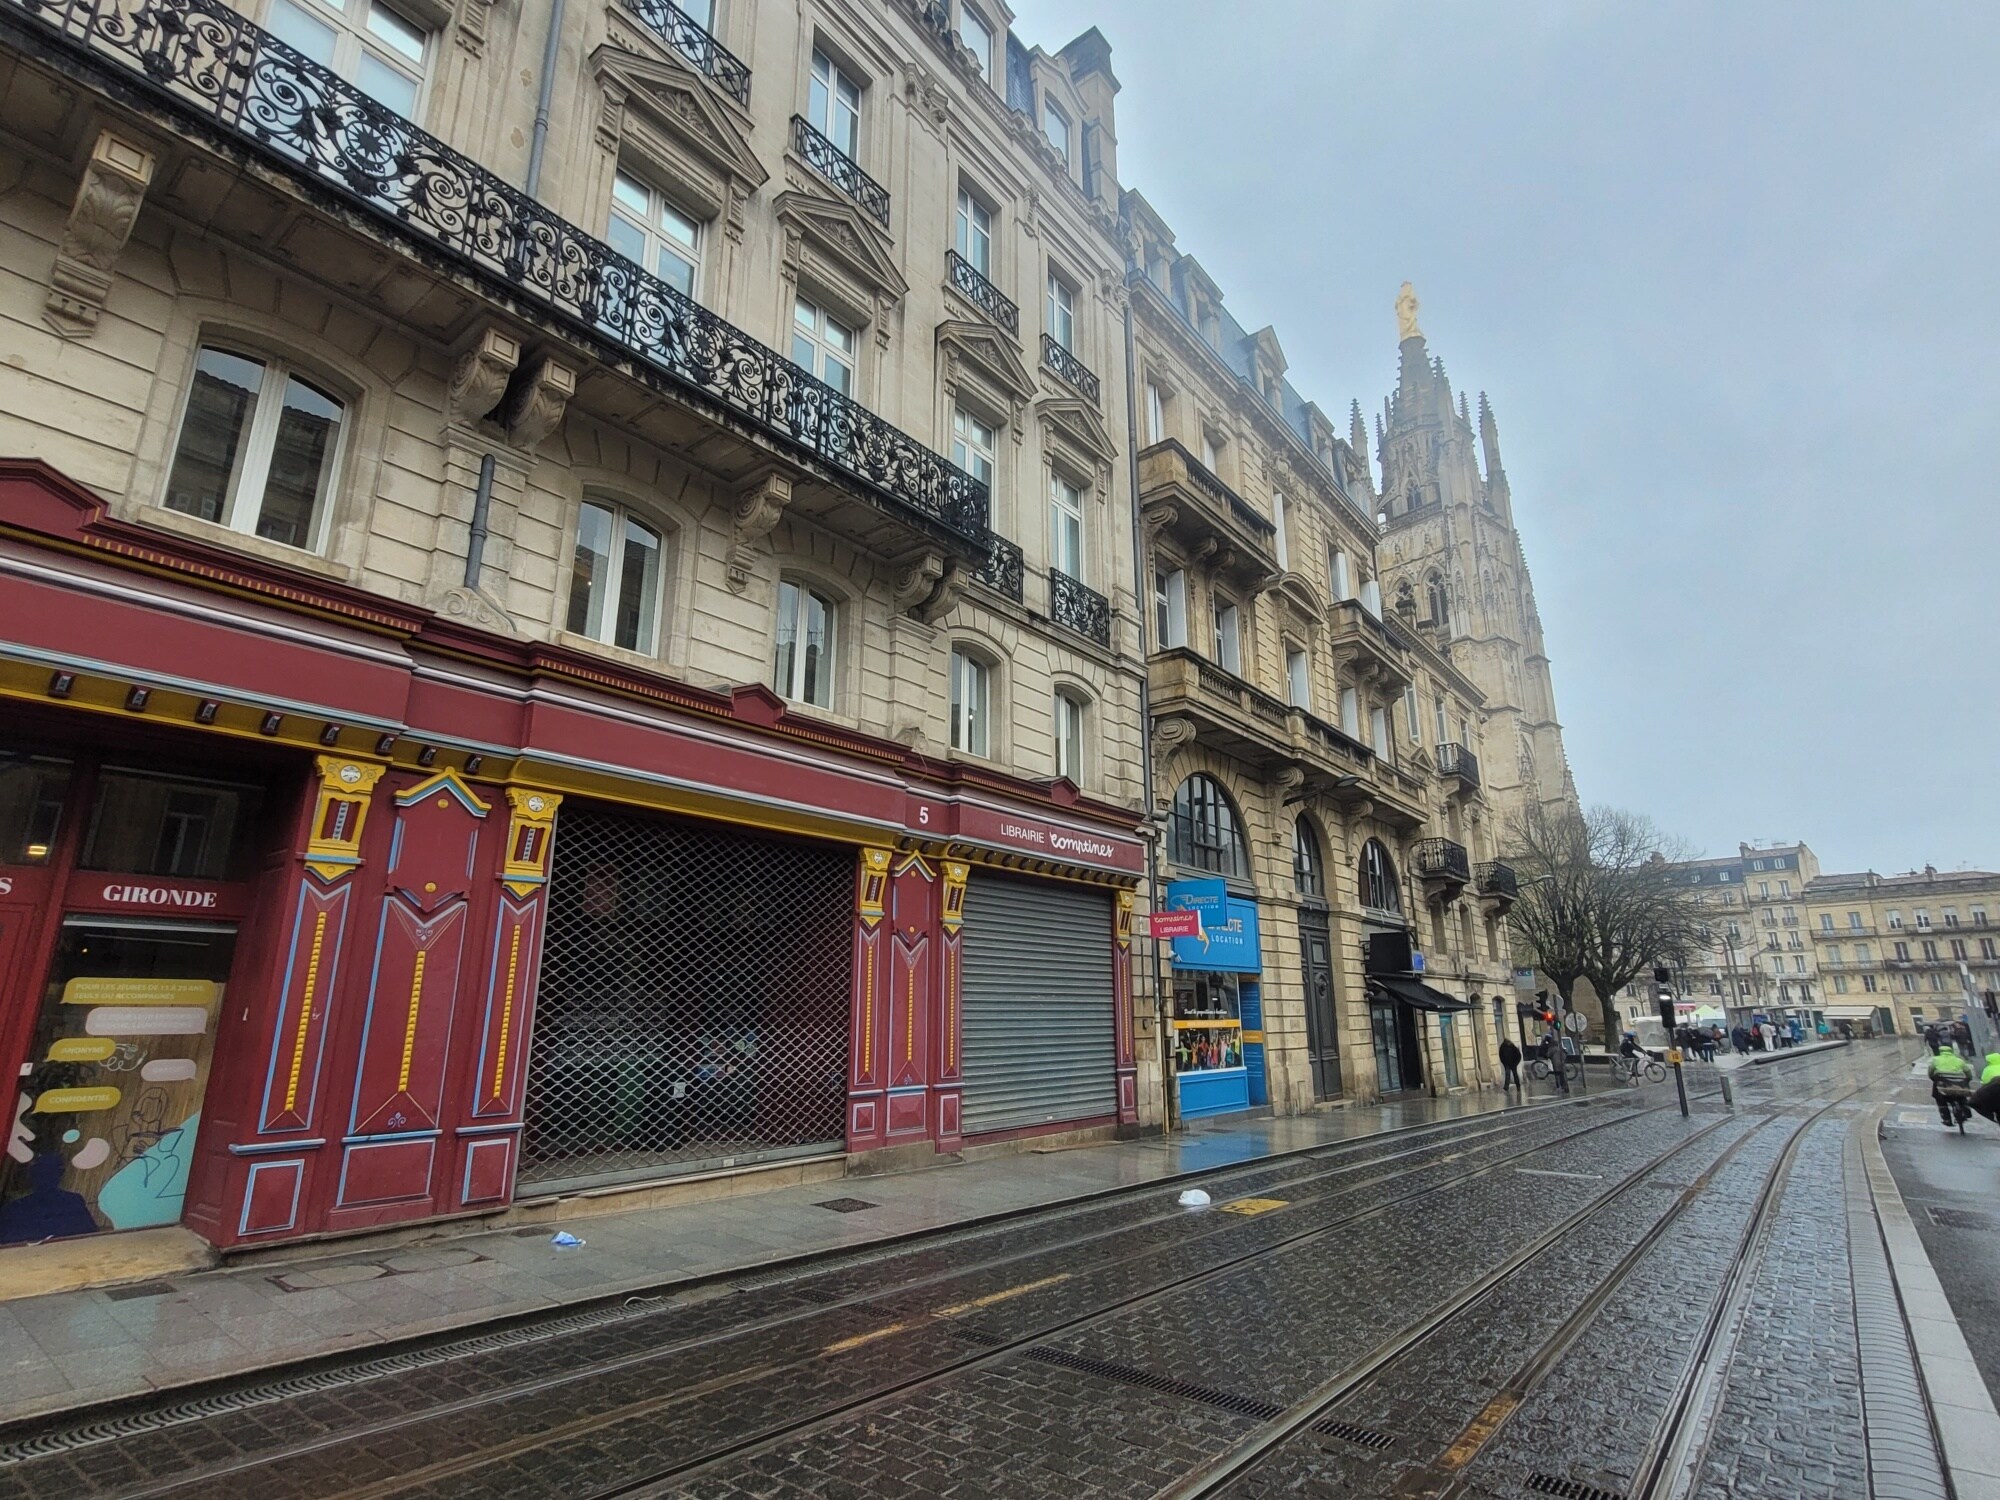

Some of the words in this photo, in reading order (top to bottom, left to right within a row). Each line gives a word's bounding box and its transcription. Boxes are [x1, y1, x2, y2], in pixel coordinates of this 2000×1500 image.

[919, 806, 929, 824] 5
[1001, 823, 1045, 844] LIBRAIRIE
[103, 884, 218, 908] GIRONDE
[1160, 925, 1190, 934] LIBRAIRIE
[1211, 935, 1244, 945] LOCATION
[75, 983, 99, 991] POUR
[62, 1046, 105, 1055] ANONYME
[49, 1094, 111, 1105] CONFIDENTIEL
